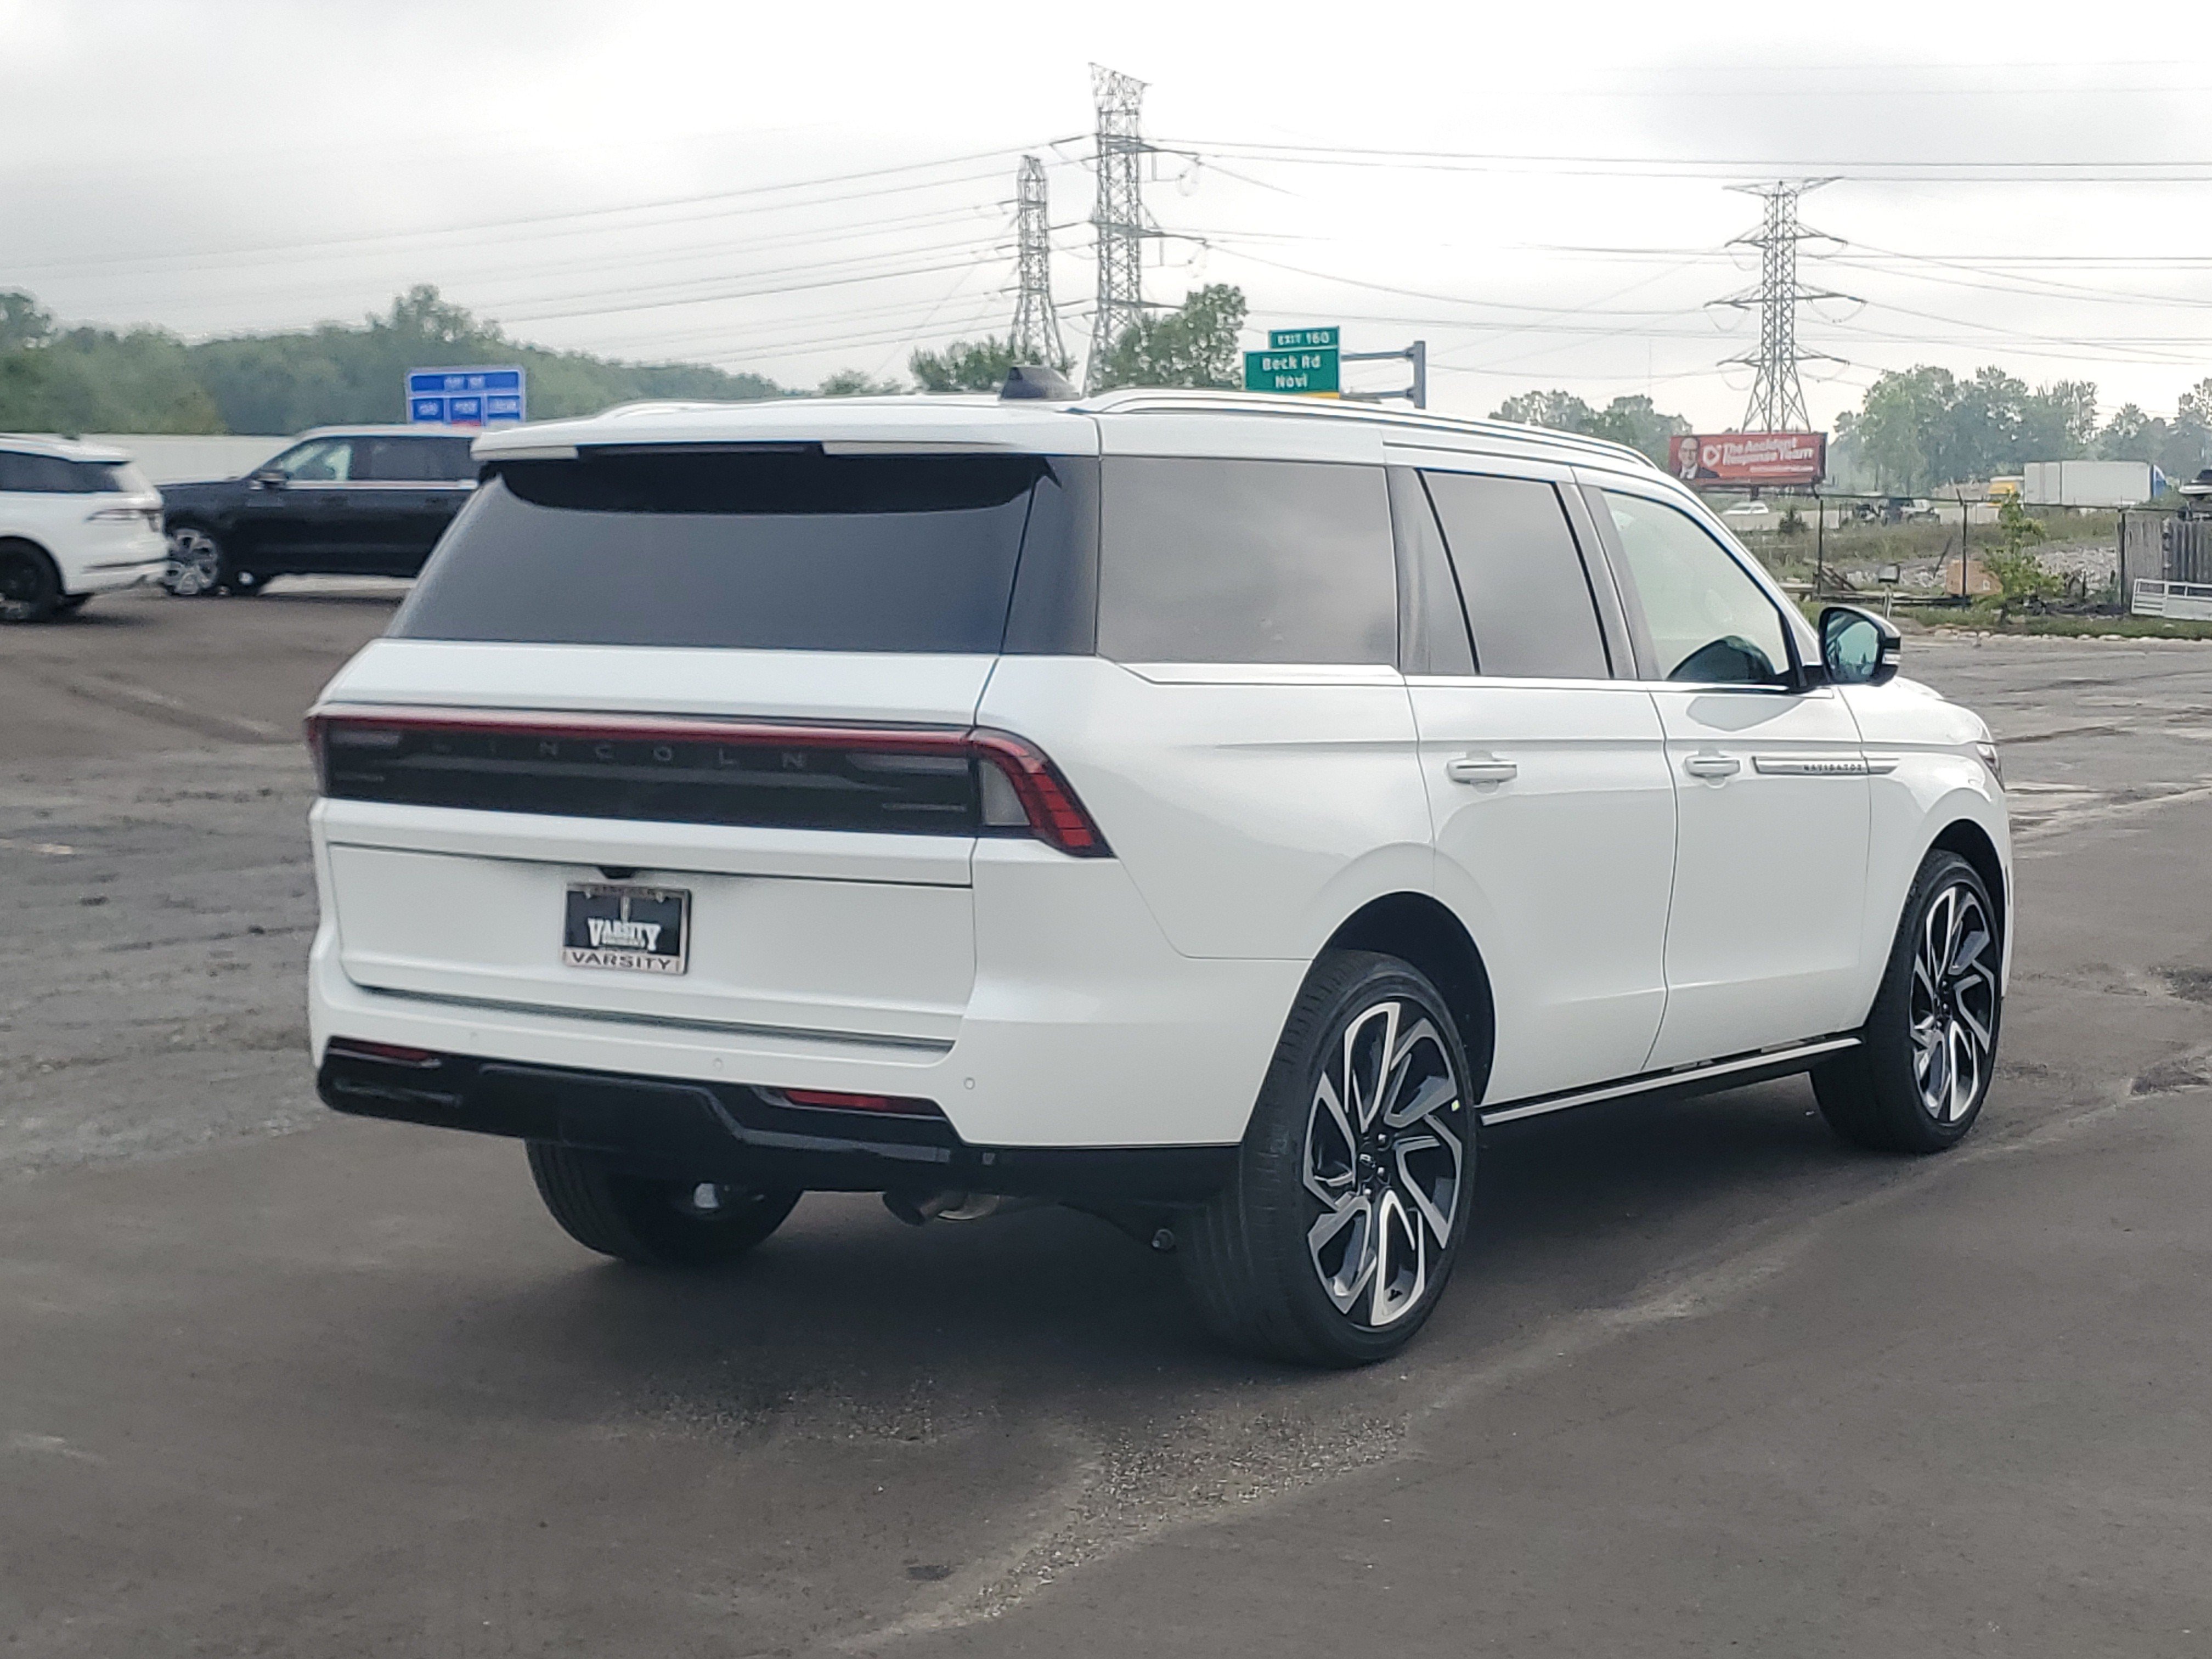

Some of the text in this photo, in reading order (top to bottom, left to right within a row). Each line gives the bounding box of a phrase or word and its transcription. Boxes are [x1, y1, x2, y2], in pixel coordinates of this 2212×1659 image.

[1277, 331, 1329, 346] EXIT 160
[1262, 355, 1321, 371] Beck Rd
[1276, 374, 1307, 388] Novi
[1723, 442, 1743, 456] The
[572, 951, 670, 969] VARSITY
